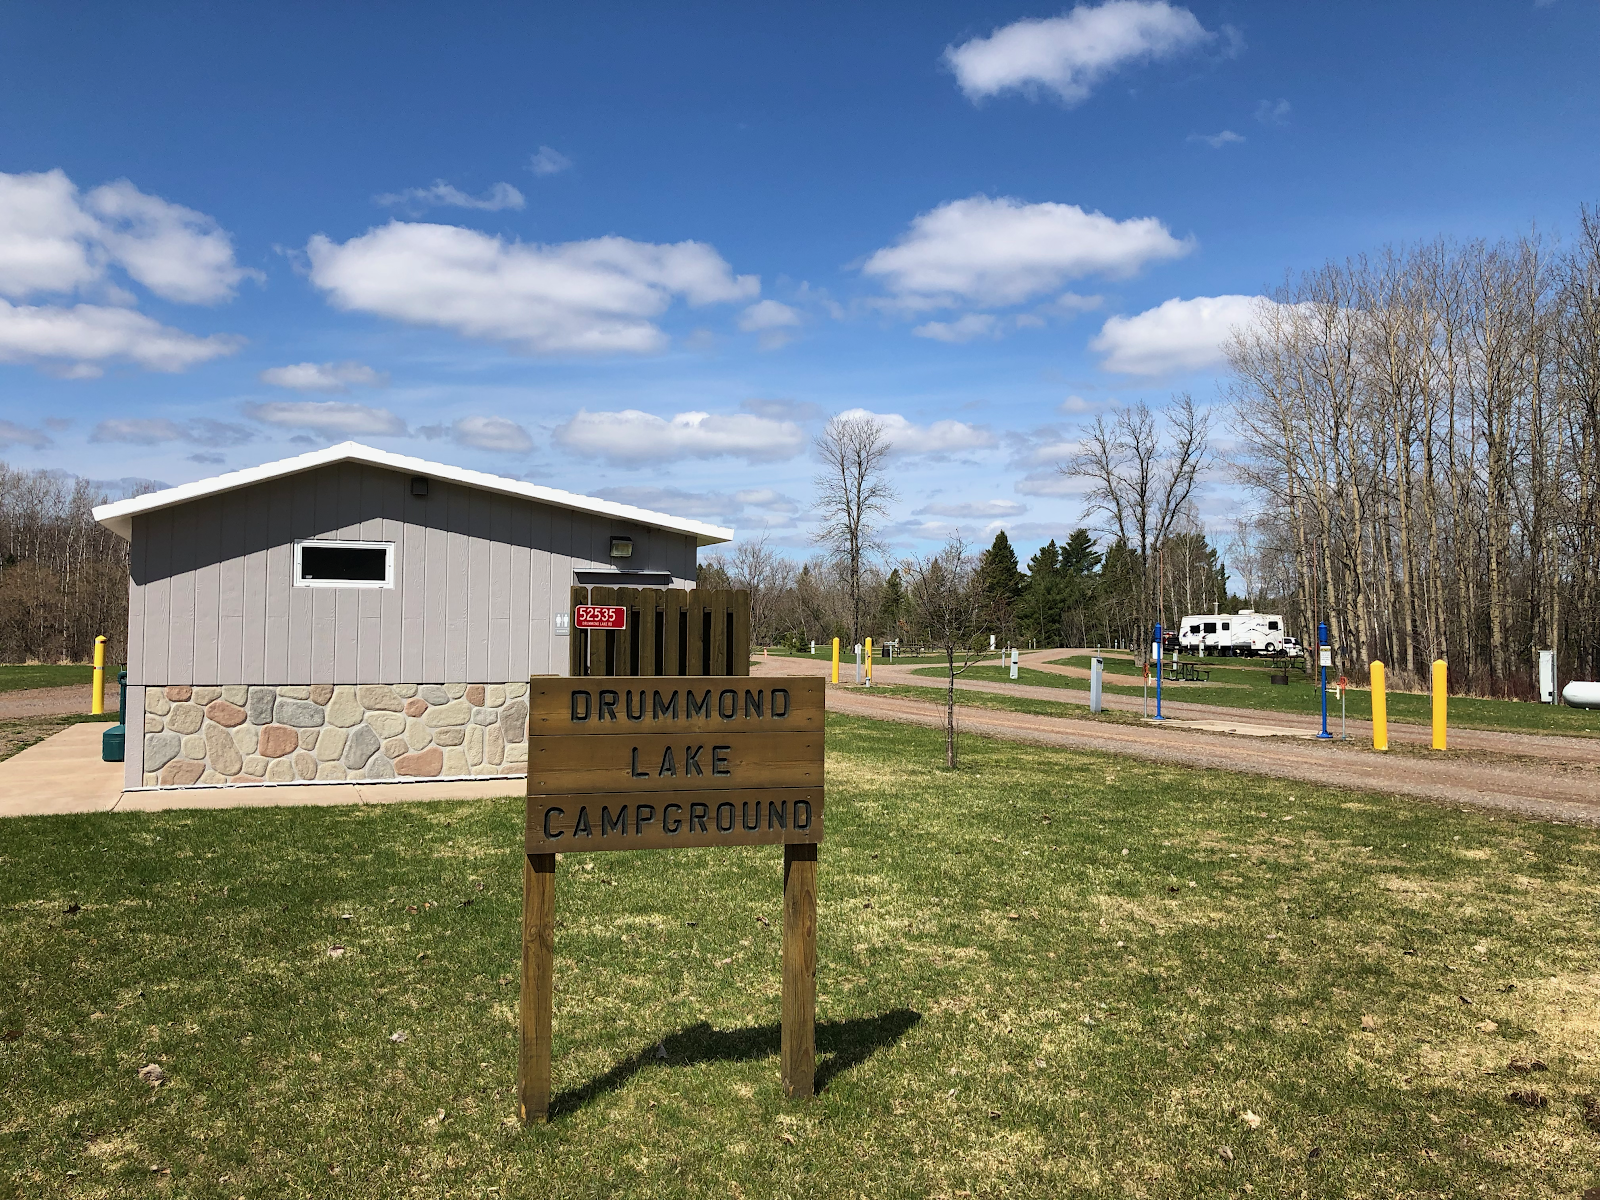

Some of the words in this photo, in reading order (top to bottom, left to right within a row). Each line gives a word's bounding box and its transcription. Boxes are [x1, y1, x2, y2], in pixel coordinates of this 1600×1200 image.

[579, 607, 616, 621] 52535
[570, 688, 790, 723] DRUMMOND
[631, 745, 731, 779] LAKE
[543, 800, 812, 840] CAMPGROUND
